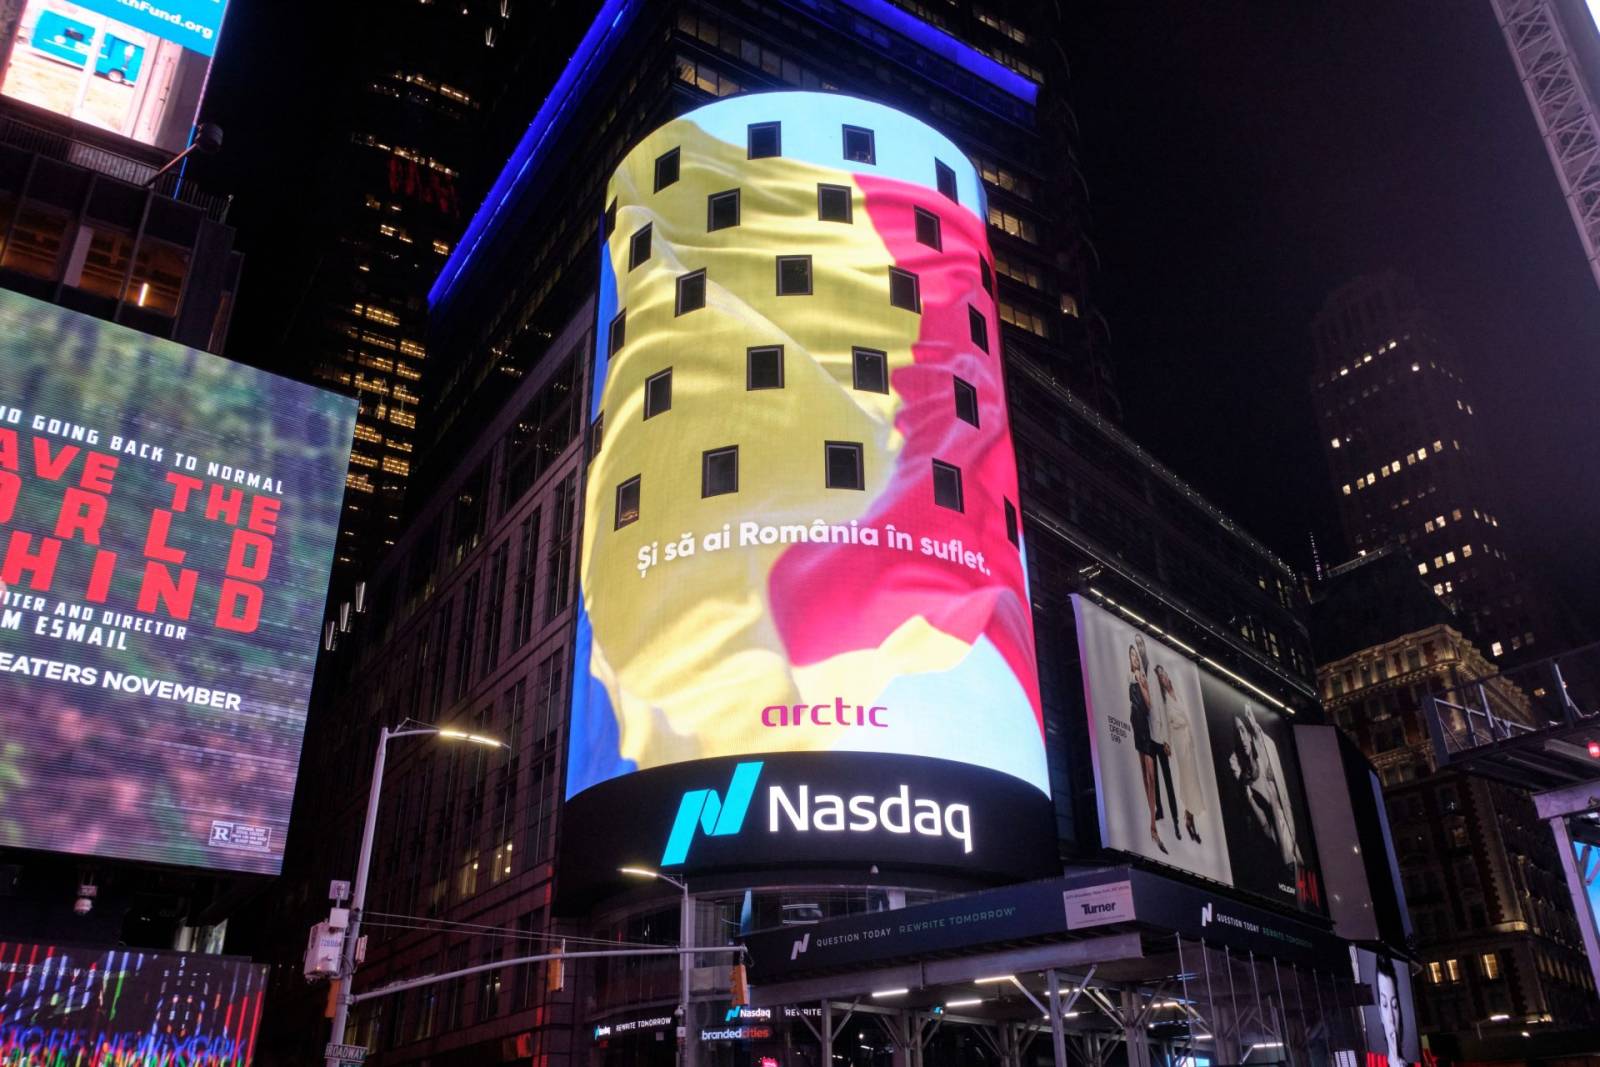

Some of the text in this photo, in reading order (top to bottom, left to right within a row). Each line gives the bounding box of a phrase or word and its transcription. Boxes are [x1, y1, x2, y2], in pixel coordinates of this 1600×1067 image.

[32, 415, 99, 446] GOING
[110, 434, 164, 463] BACK
[175, 453, 198, 472] TO
[207, 463, 285, 495] NORMAL
[165, 471, 282, 536] THE
[636, 519, 991, 578] Și să ai România în suflet.
[1, 530, 265, 634] HIND
[35, 615, 128, 651] ESMAIL
[54, 602, 94, 621] AND
[102, 610, 187, 640] DIRECTOR
[102, 671, 242, 712] NOVEMBER
[761, 697, 889, 728] arctic
[213, 827, 229, 841] R
[768, 785, 973, 854] Nasdaq
[1081, 902, 1116, 915] Turner
[1216, 912, 1243, 929] QUESTION
[1242, 921, 1260, 934] TODAY
[816, 932, 860, 948] QUESTION
[863, 927, 892, 940] TODAY
[898, 918, 945, 935] REWRITE
[637, 1016, 672, 1028] TOMORROW
[740, 1008, 771, 1019] Nasdaq
[324, 1045, 367, 1060] BROADWAY
